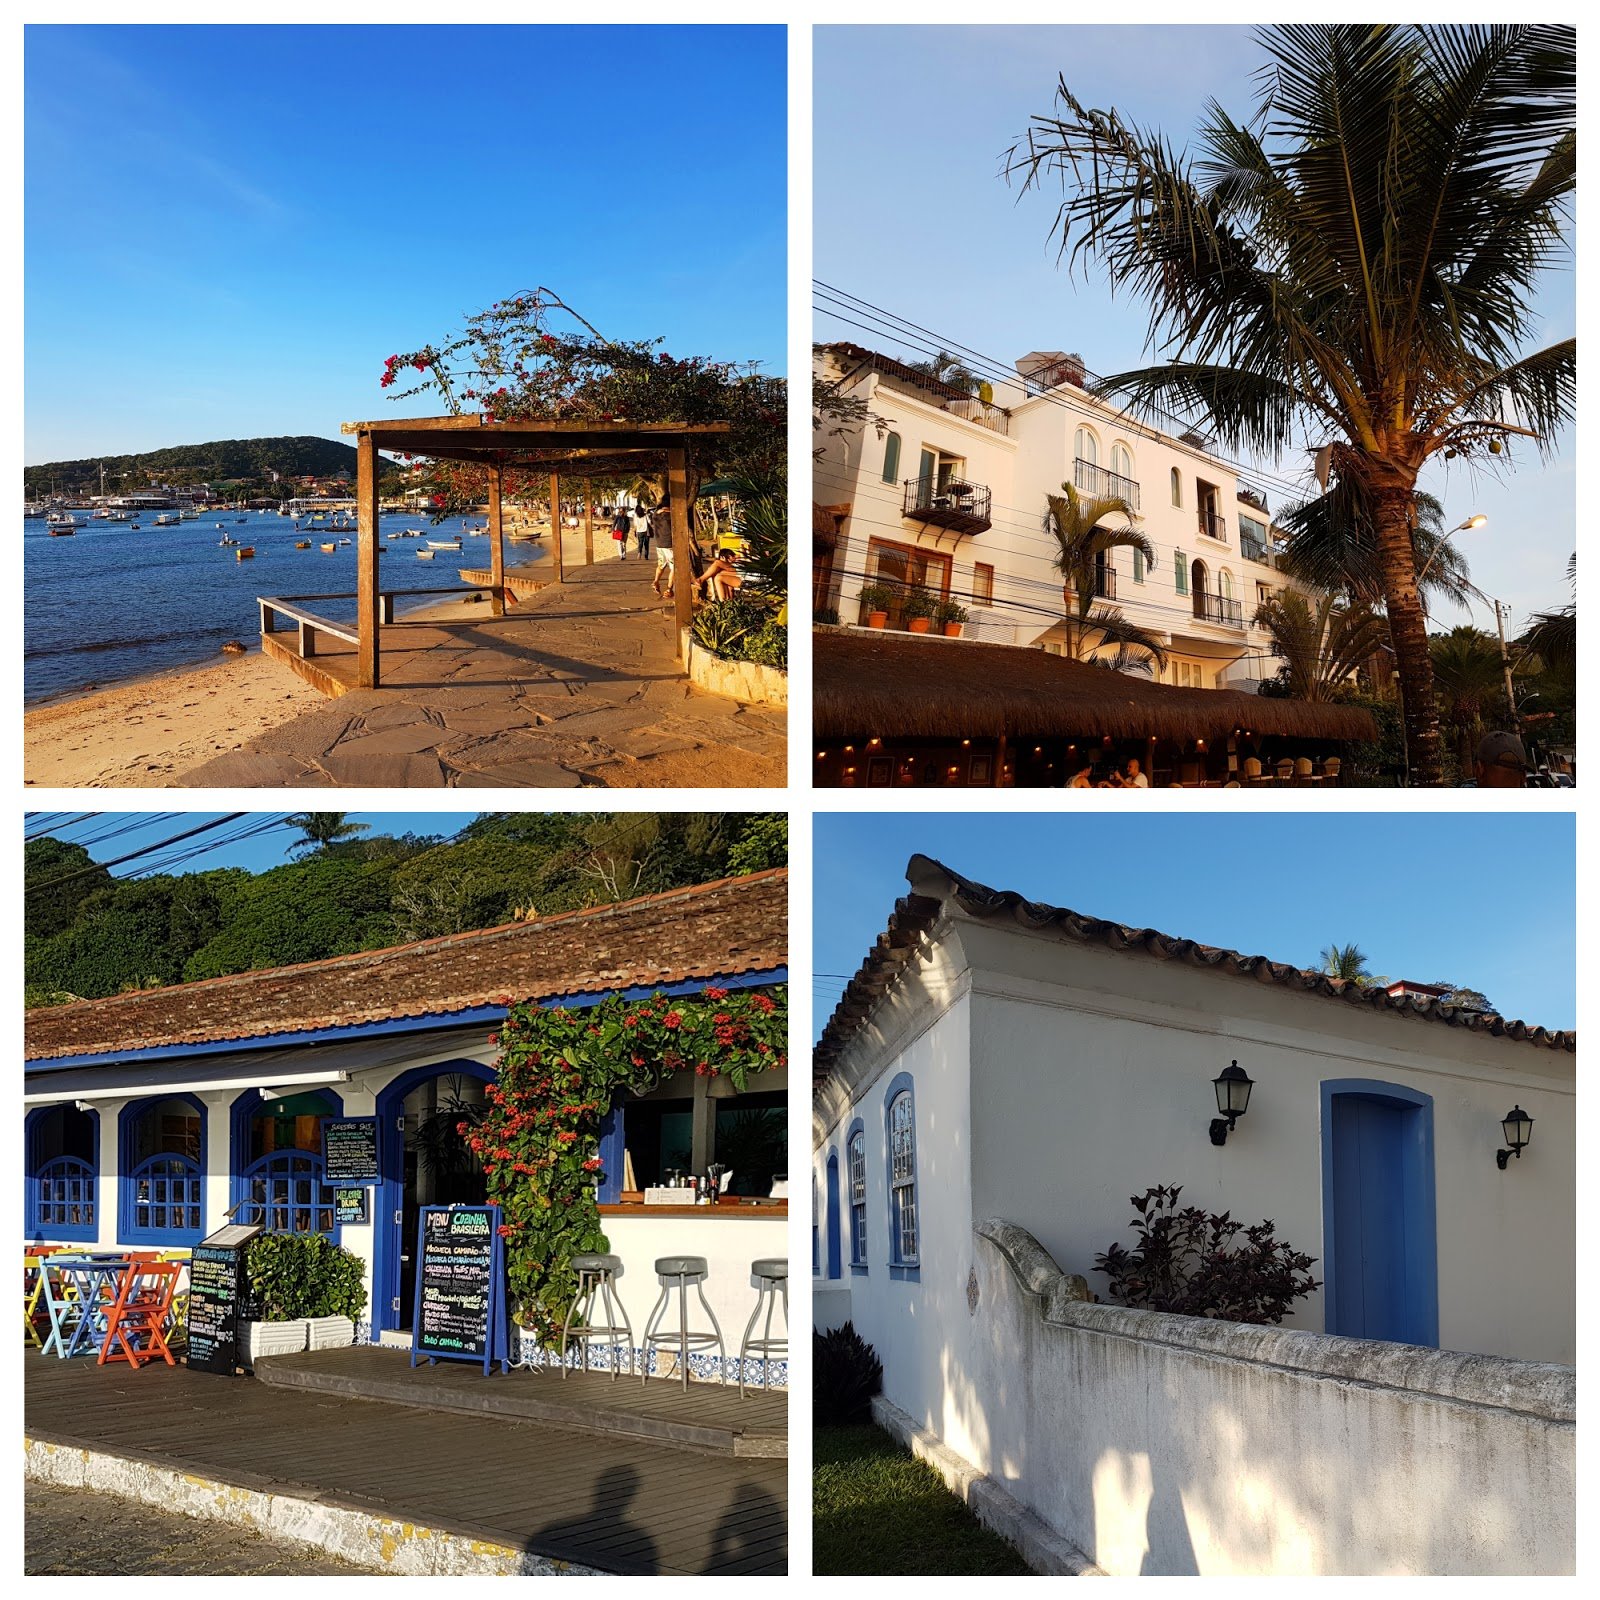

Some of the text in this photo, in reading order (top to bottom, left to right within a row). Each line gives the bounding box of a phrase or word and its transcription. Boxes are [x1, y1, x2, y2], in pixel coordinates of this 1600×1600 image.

[336, 1189, 362, 1200] WELCOME
[341, 1199, 359, 1208] DRINK
[427, 1212, 488, 1227] MENU COZINHA
[450, 1225, 490, 1235] BRASILEIRA
[426, 1244, 451, 1255] MOQUECA
[453, 1246, 479, 1255] CAMARÃO
[426, 1255, 447, 1264] MOQUECA
[425, 1264, 452, 1274] CALDEIRADA
[439, 1337, 463, 1348] CAMARÃO
